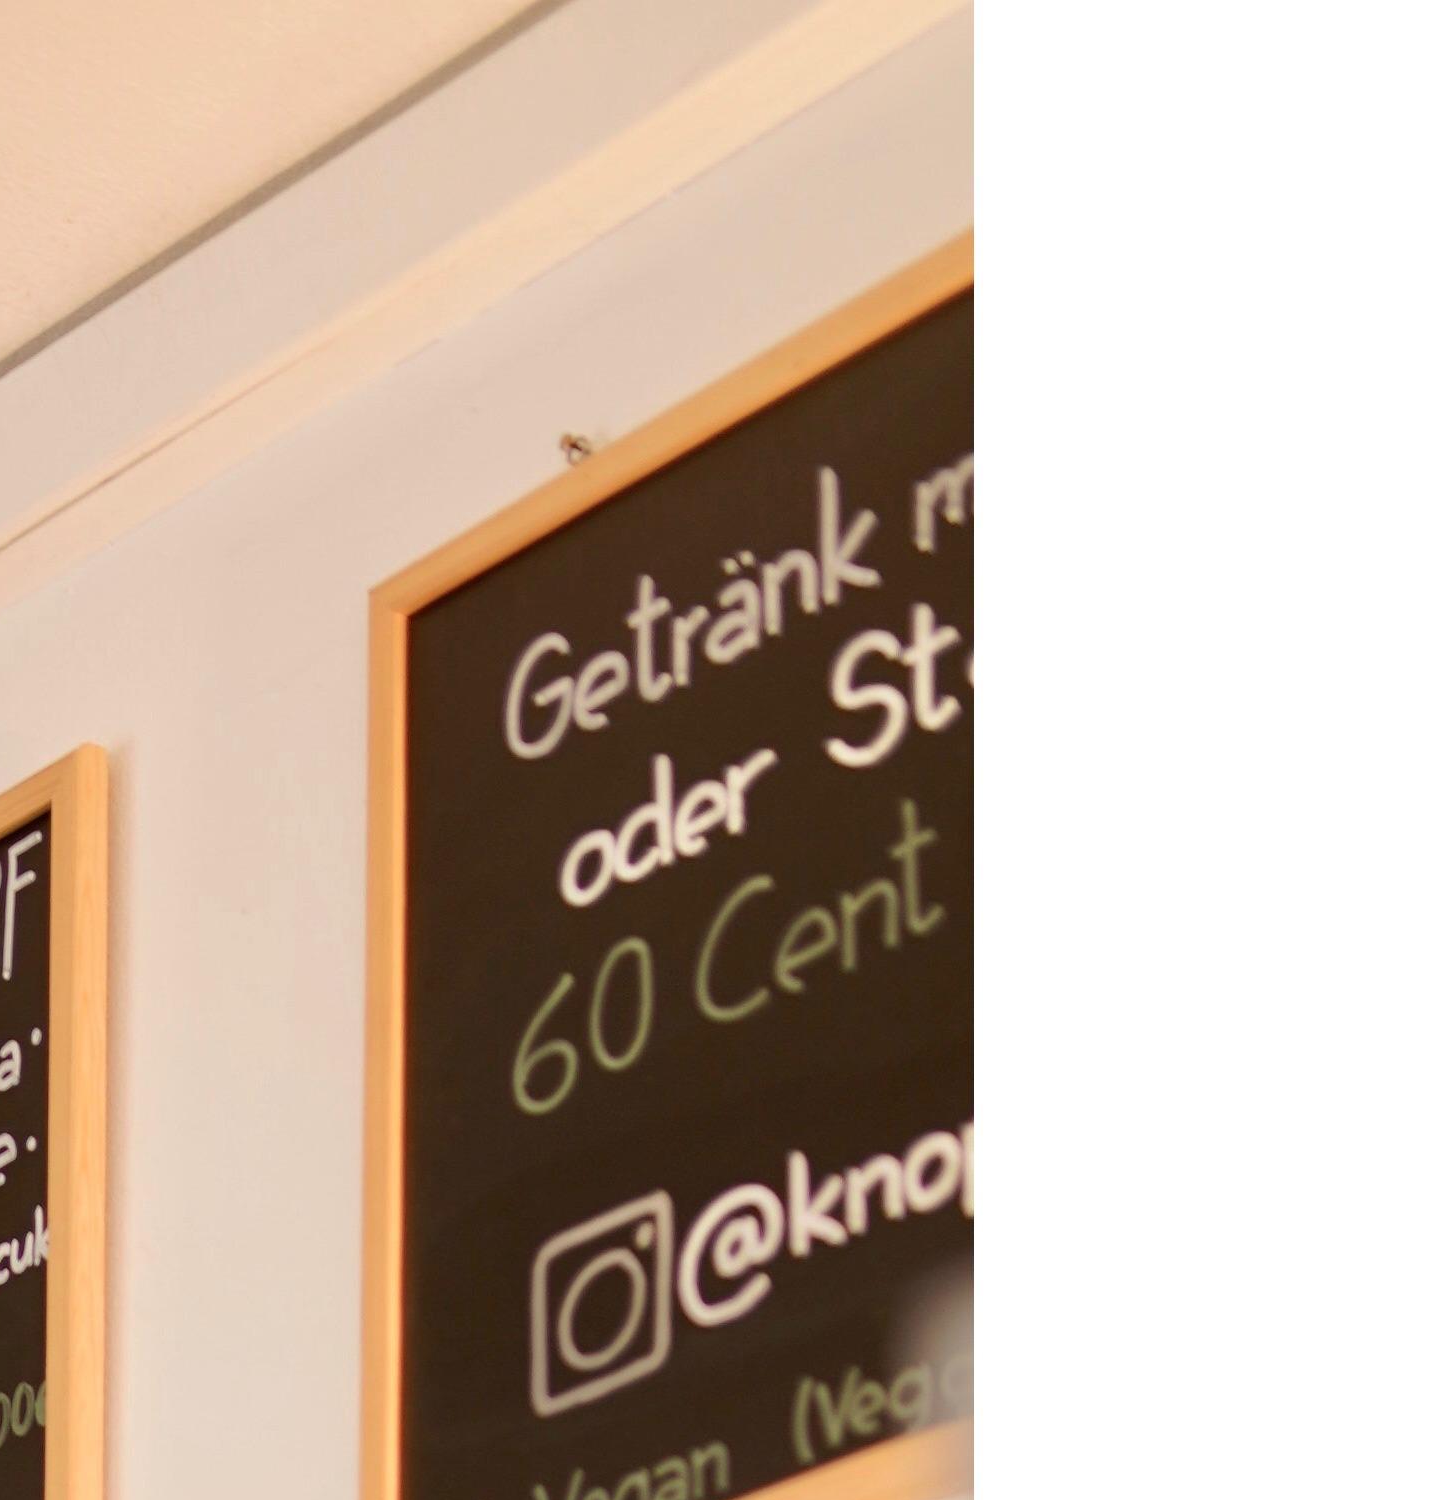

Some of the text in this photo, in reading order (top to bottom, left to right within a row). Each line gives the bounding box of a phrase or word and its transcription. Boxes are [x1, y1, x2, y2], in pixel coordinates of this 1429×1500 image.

[504, 466, 882, 760] Getränk
[559, 602, 974, 907] oder St
[512, 798, 944, 1114] 60 Cent
